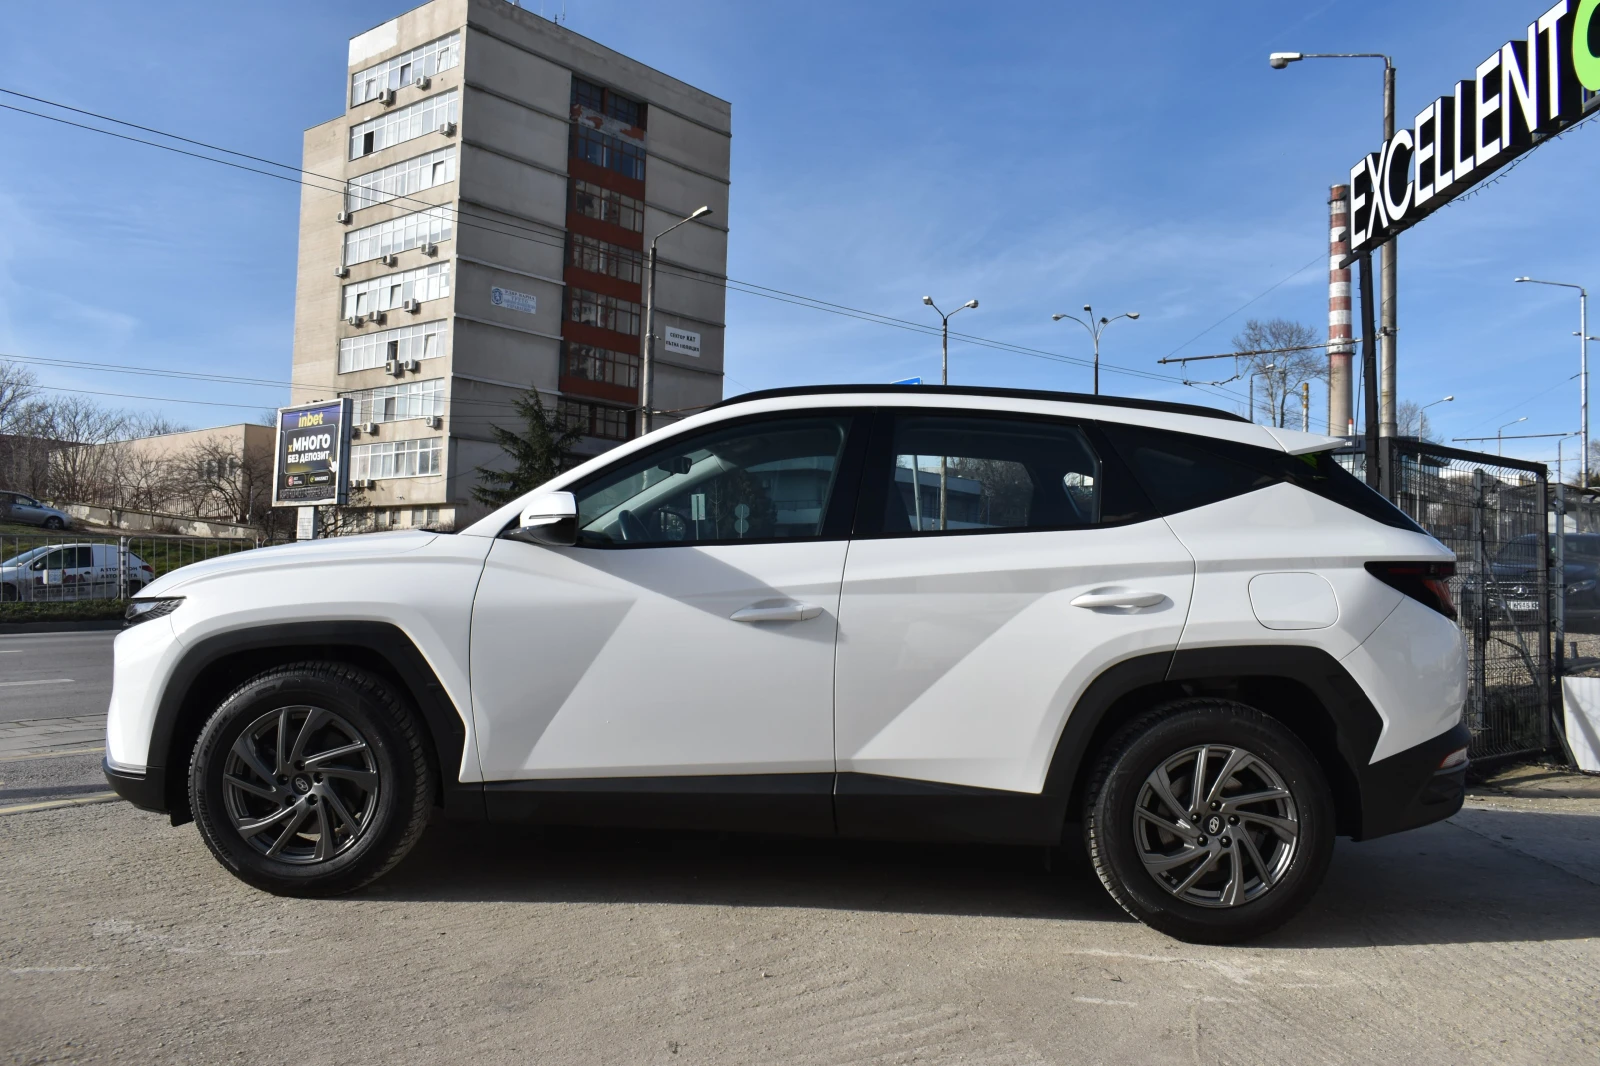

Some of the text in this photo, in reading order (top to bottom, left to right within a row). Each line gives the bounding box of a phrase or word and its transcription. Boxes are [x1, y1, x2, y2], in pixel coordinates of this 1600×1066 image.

[1350, 0, 1569, 250] EXCELLENT
[298, 411, 323, 427] inbet
[287, 450, 330, 464] БЕЗ ДЕПОЗИТ
[196, 788, 233, 860] BRIDGESTONE
